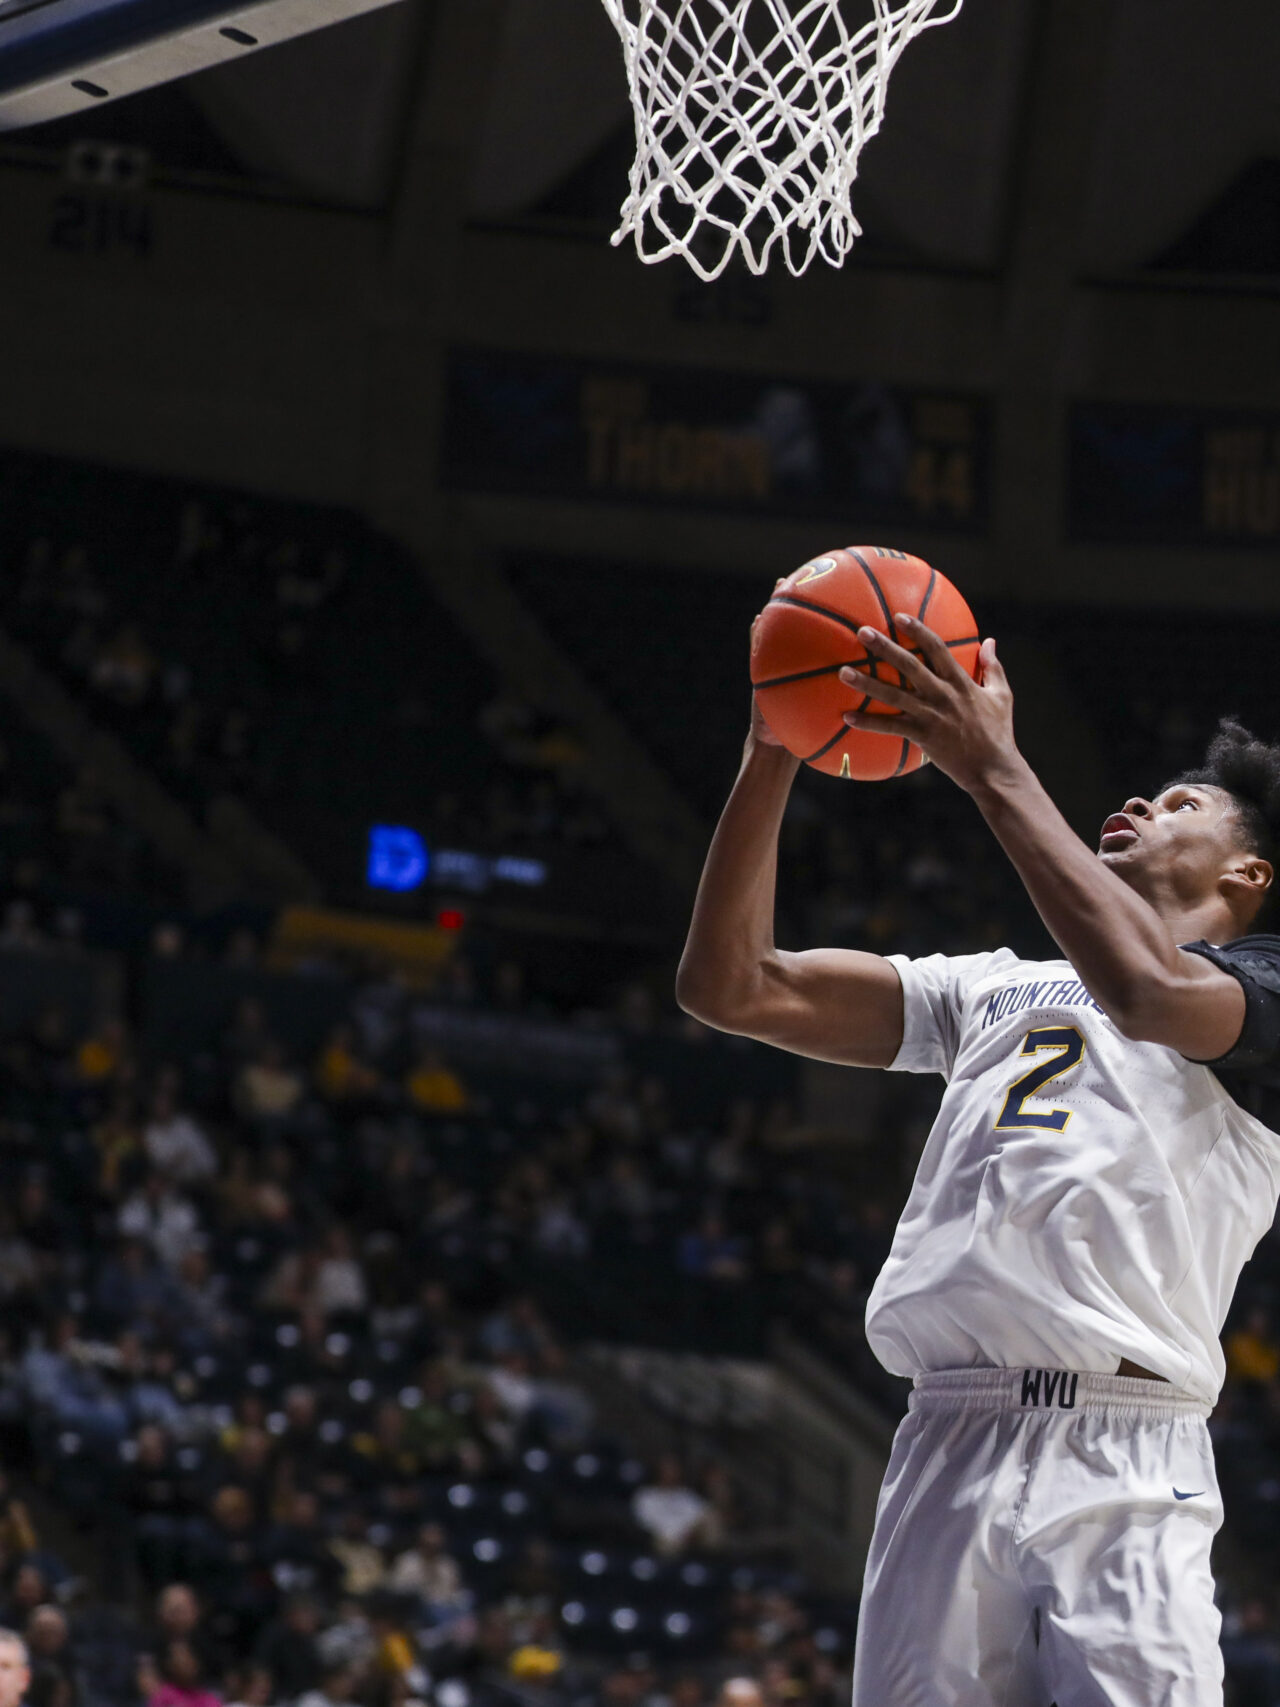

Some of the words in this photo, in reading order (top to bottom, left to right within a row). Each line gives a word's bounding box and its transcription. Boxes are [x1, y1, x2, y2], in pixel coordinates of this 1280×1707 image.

[49, 195, 152, 256] 214
[993, 1025, 1086, 1133] 2
[1021, 1369, 1078, 1409] WVU
